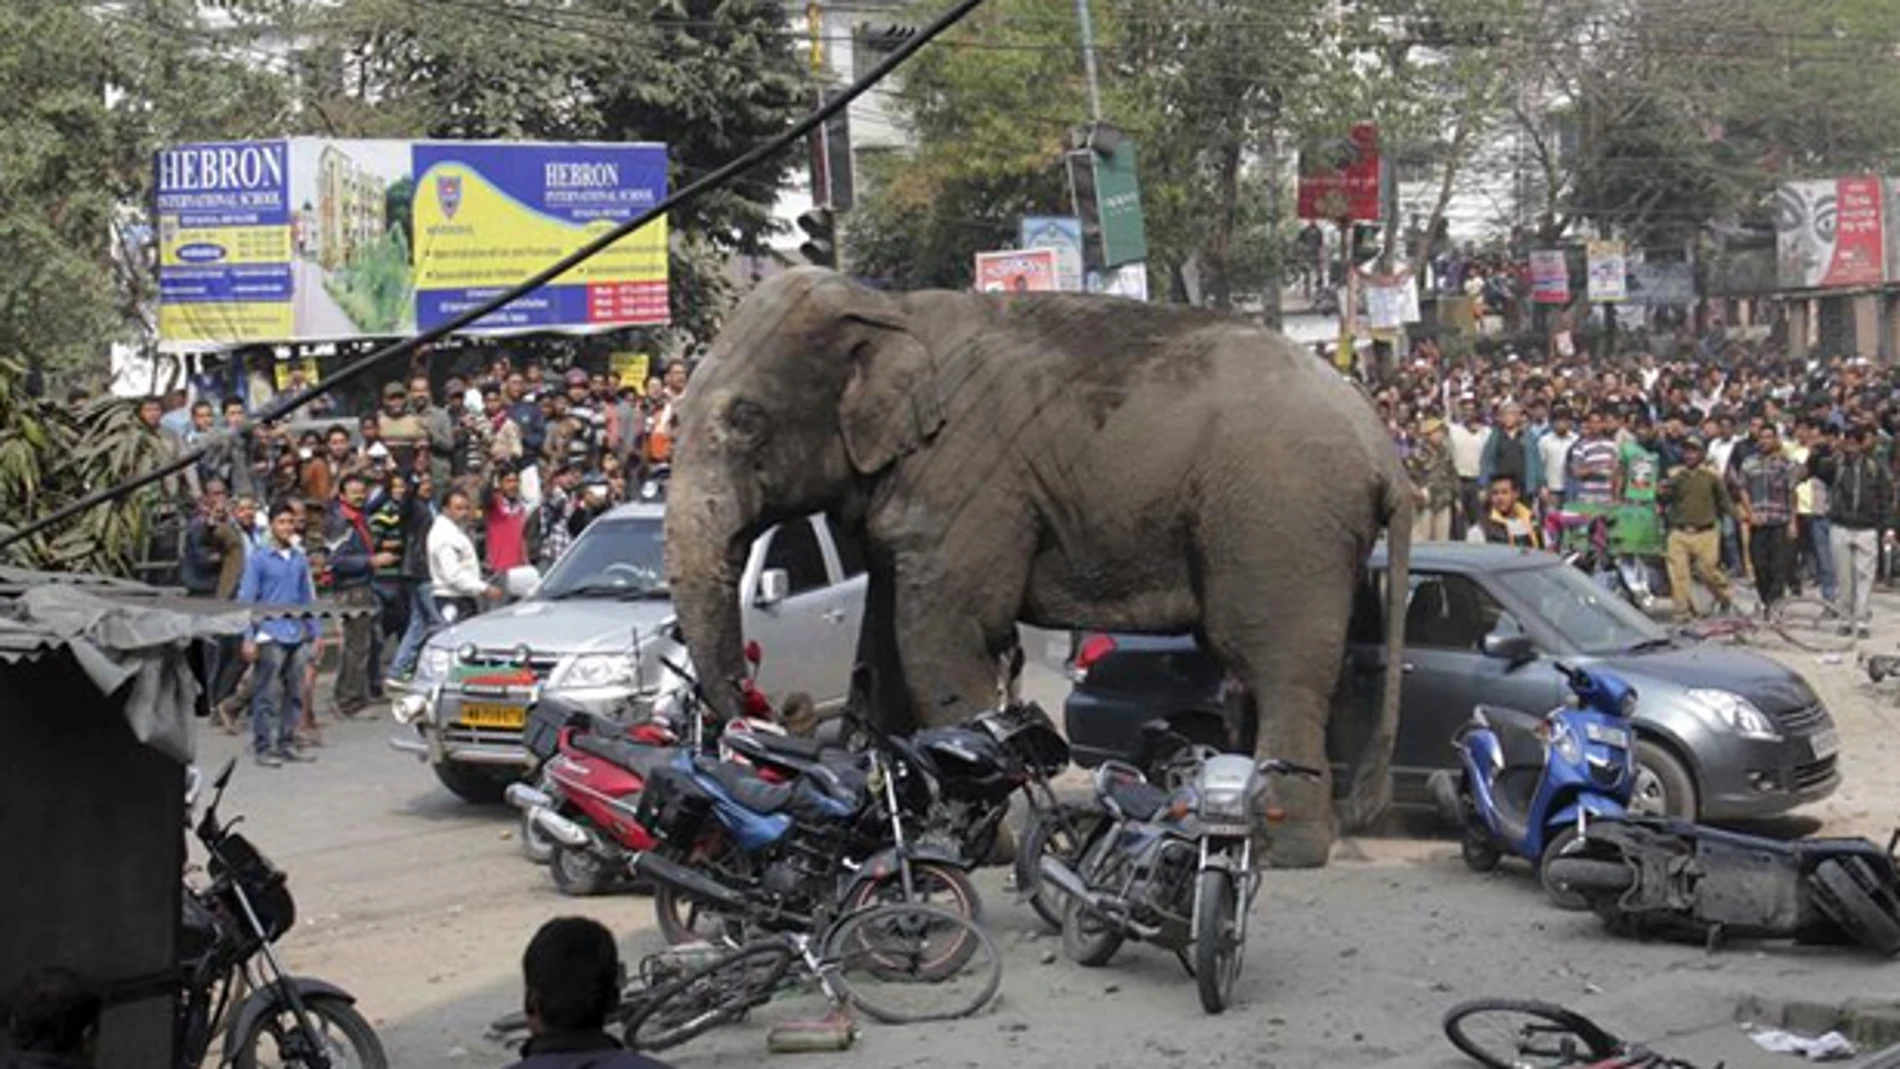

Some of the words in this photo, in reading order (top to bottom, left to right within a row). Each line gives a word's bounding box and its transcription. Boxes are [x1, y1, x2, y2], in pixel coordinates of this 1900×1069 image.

[159, 147, 283, 190] HEBRON
[545, 163, 619, 187] HEBRON
[158, 194, 236, 208] INTERNATIONAL
[240, 192, 282, 206] SCHOOL
